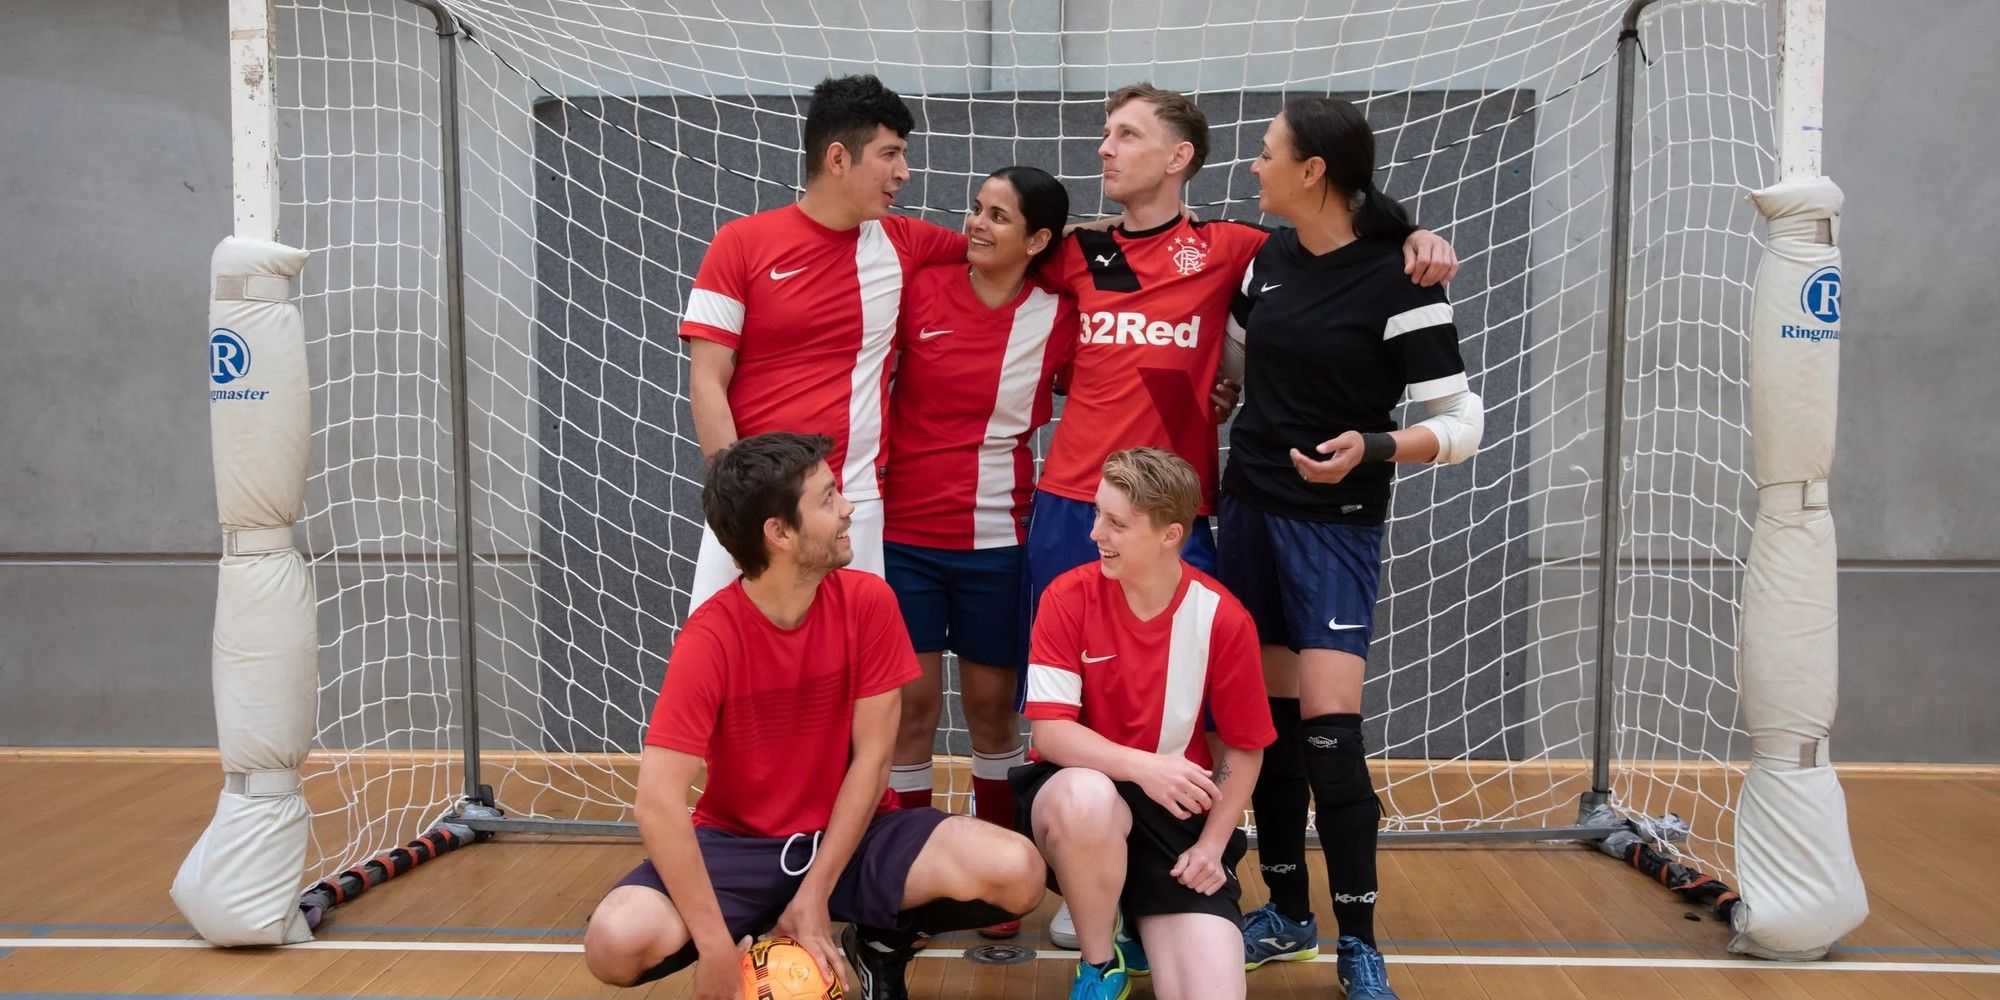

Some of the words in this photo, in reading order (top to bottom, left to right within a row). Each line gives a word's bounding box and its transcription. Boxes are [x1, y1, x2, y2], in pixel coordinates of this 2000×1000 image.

[1814, 280, 1840, 316] R
[1079, 311, 1201, 349] 32Red
[1781, 325, 1840, 343] Ringma
[210, 341, 244, 378] R
